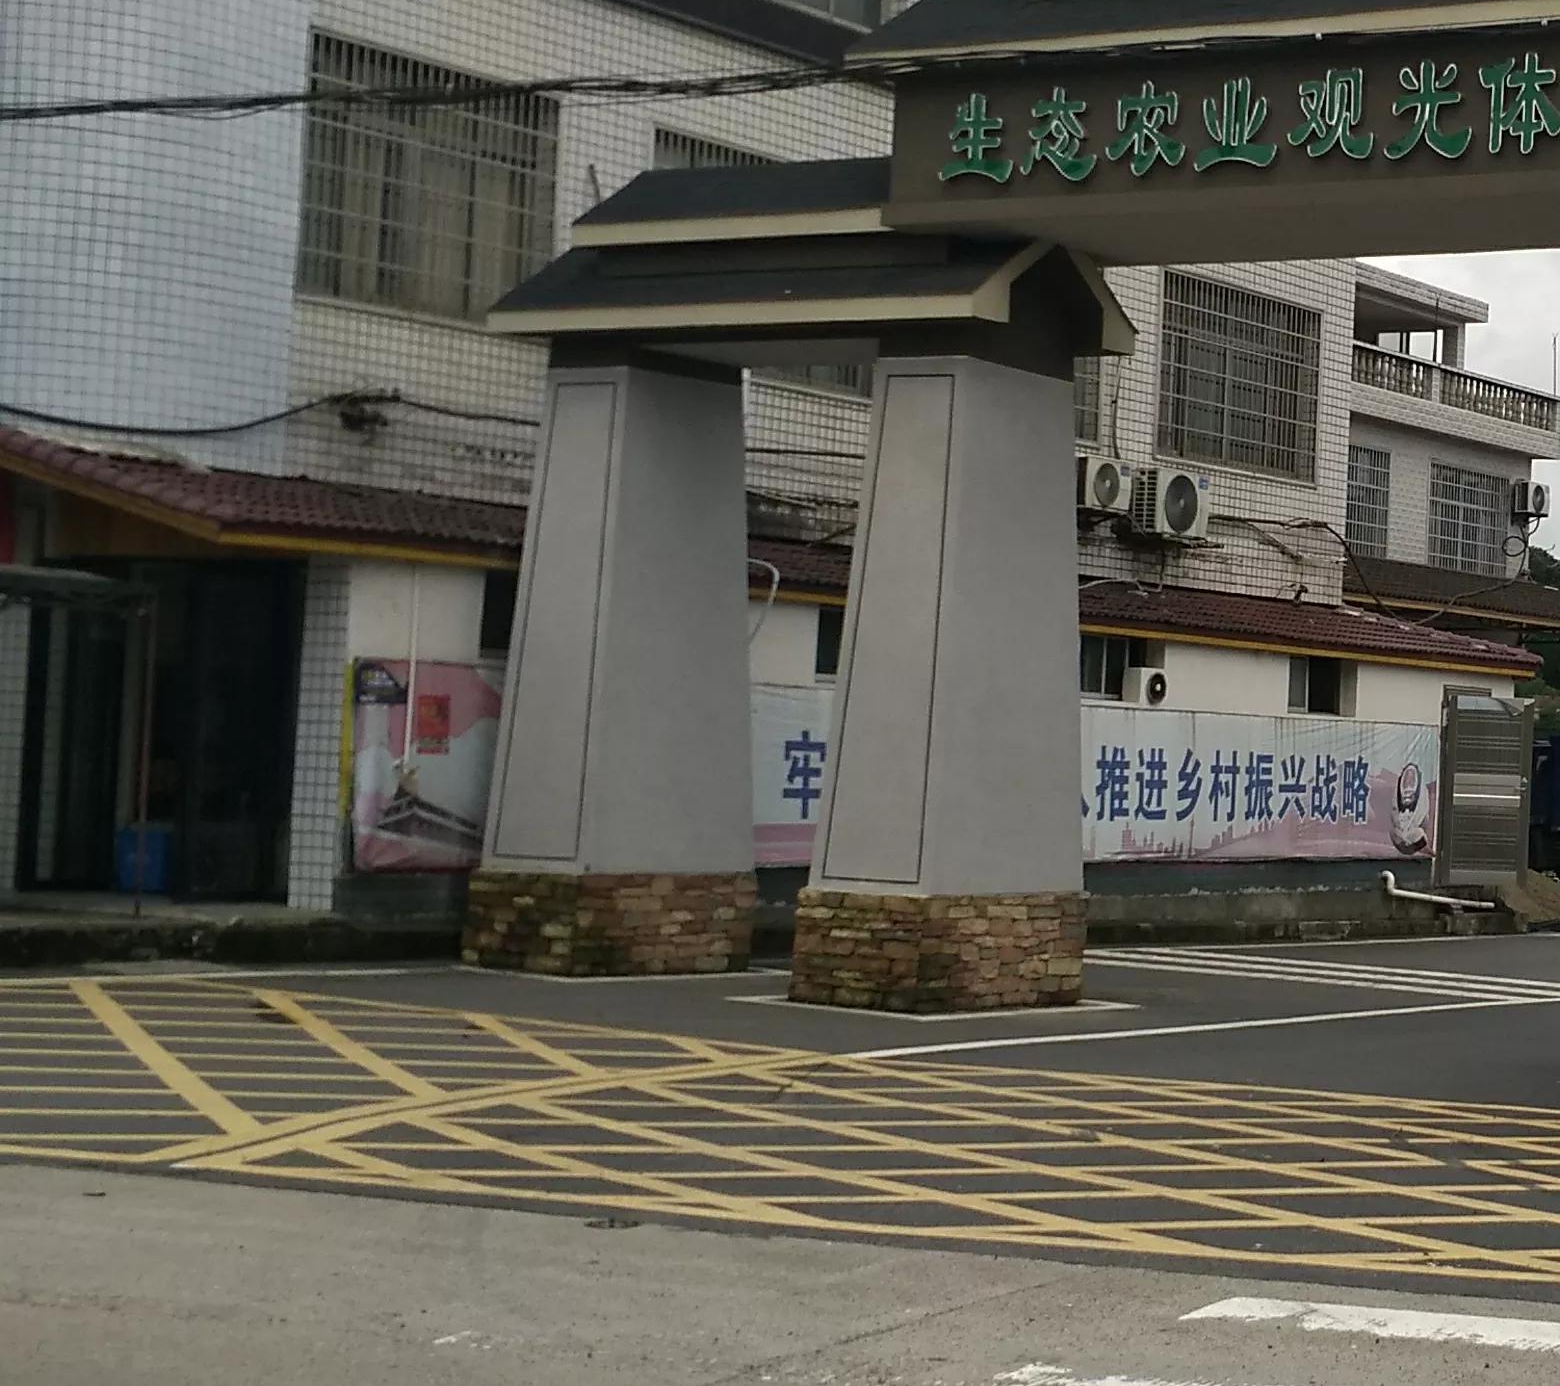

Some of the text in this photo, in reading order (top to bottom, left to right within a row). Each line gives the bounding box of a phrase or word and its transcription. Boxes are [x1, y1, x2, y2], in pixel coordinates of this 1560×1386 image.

[783, 729, 1370, 824] 牢 推进乡村振兴战略
